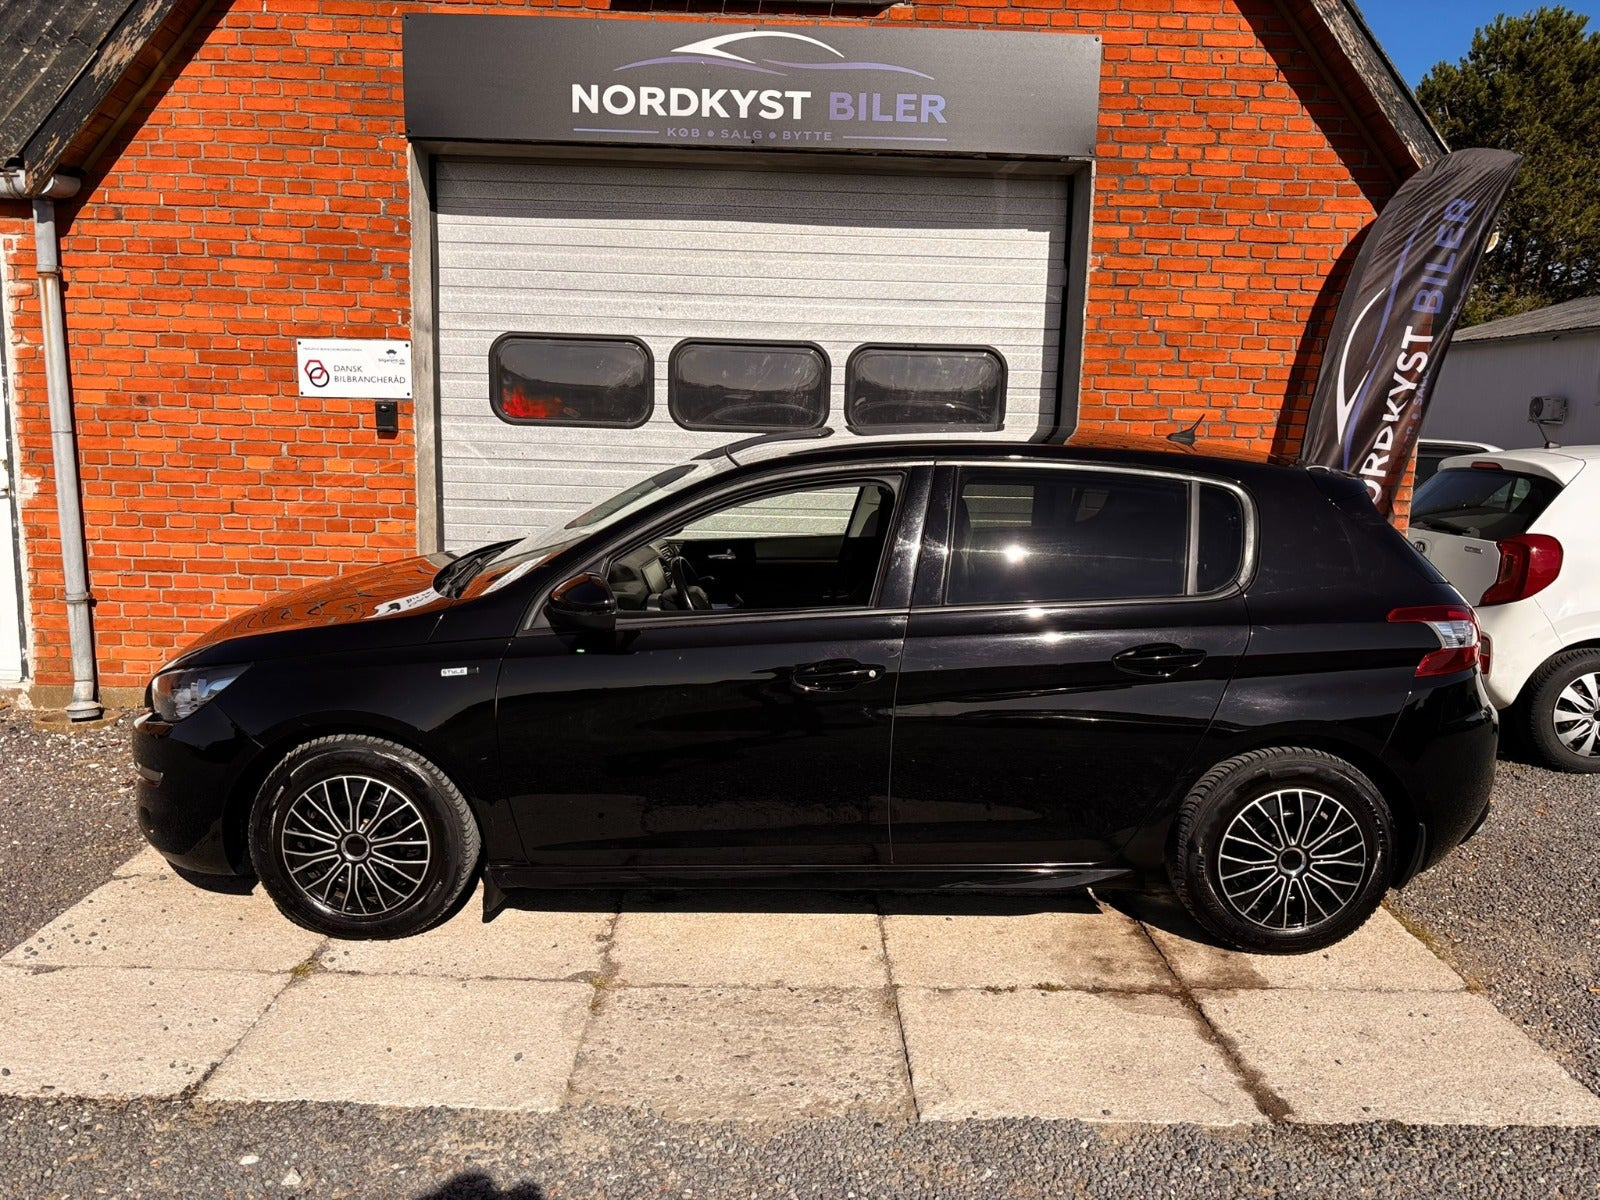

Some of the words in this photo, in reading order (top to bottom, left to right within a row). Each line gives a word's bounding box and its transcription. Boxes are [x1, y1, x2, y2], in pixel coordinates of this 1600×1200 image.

[571, 83, 811, 120] NORDKYST
[829, 91, 947, 124] BILER
[667, 127, 700, 138] KØB
[720, 129, 763, 140] SALG
[782, 131, 833, 141] BYTTE
[1359, 325, 1434, 505] ORDKYST
[1412, 198, 1477, 314] BILER
[333, 364, 364, 373] DANSK
[334, 375, 406, 384] BILBRANCHERÅD
